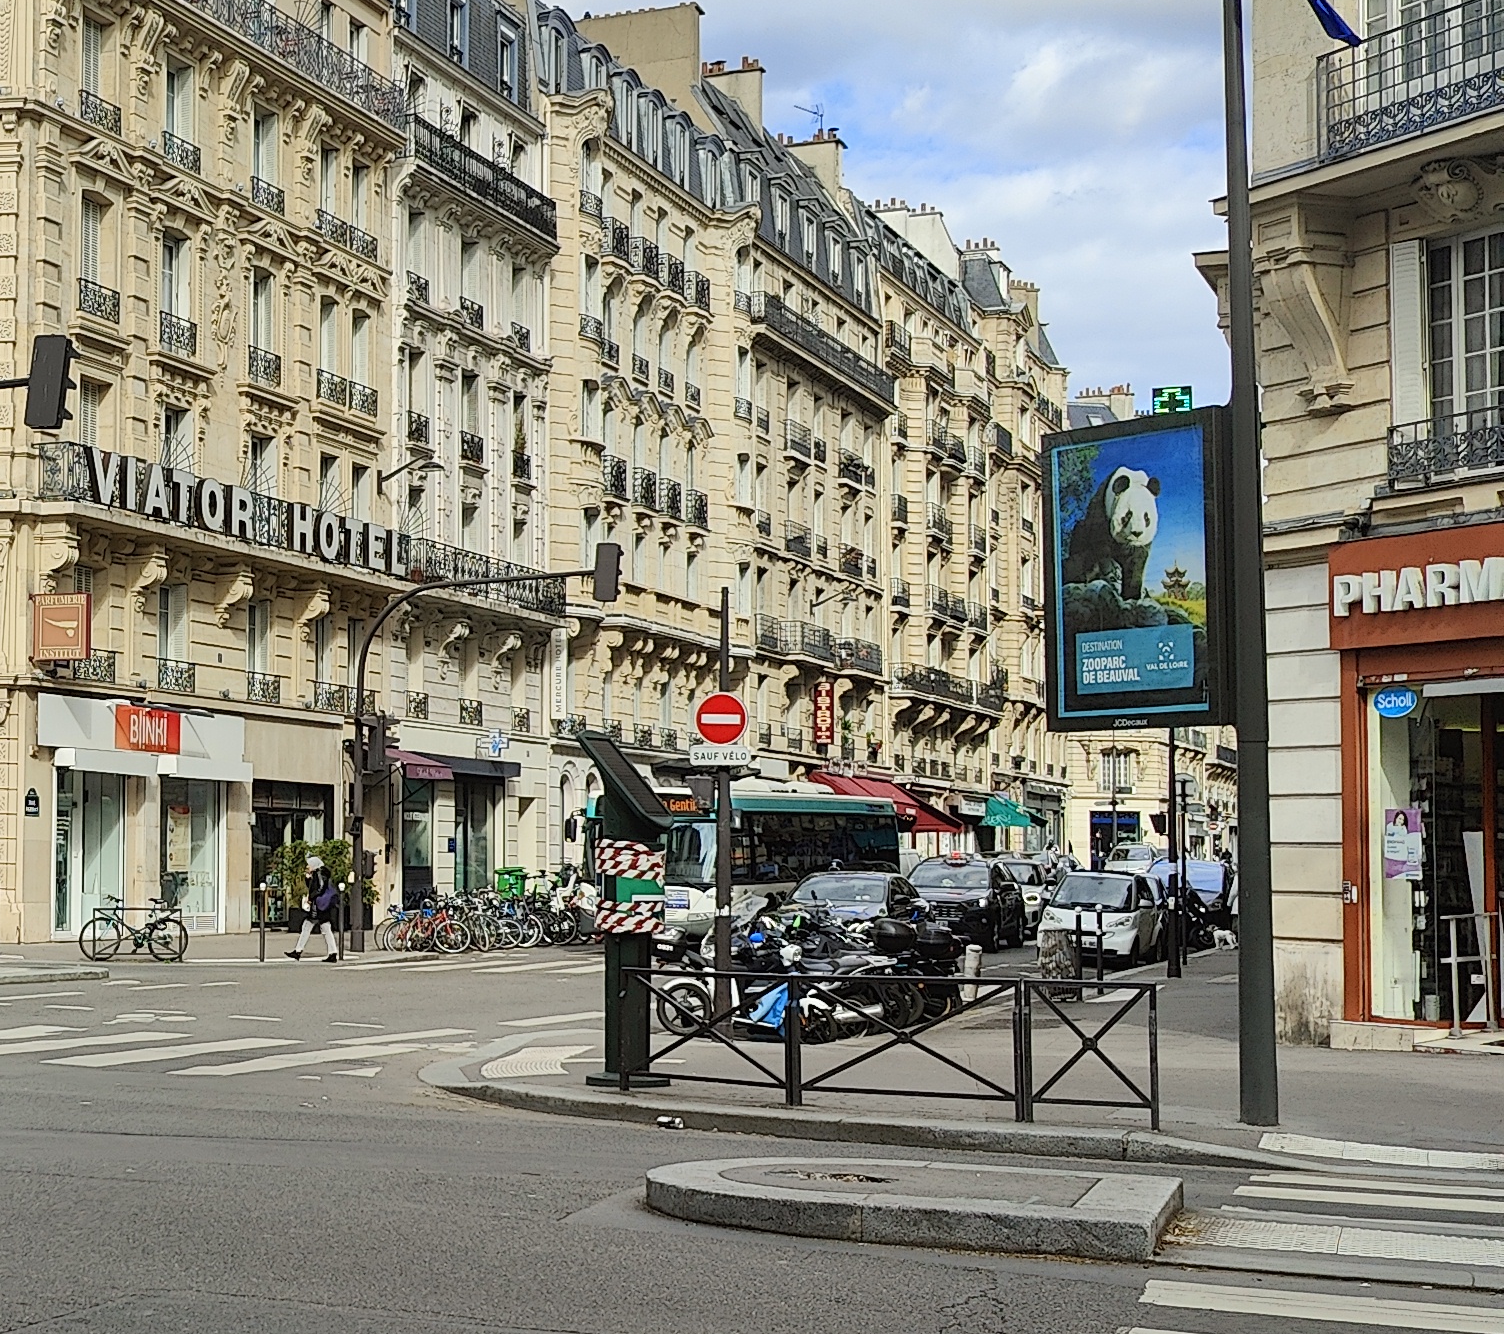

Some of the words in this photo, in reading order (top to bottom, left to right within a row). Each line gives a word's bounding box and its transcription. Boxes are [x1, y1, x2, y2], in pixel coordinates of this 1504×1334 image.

[85, 446, 253, 541] VIATOR
[289, 501, 407, 577] HOTEL
[36, 595, 86, 605] PARFUMERIE
[1081, 640, 1123, 653] DESTINATION
[1082, 656, 1127, 671] ZOOPARC
[1170, 661, 1189, 669] LOIRE
[1083, 671, 1095, 684] DE
[1096, 668, 1141, 683] BEAUVAL
[1377, 691, 1413, 708] Scholl
[816, 682, 831, 732] BISTROT
[1112, 719, 1148, 727] JCDecaux
[693, 752, 719, 760] SAUF
[721, 750, 747, 760] VÉLO
